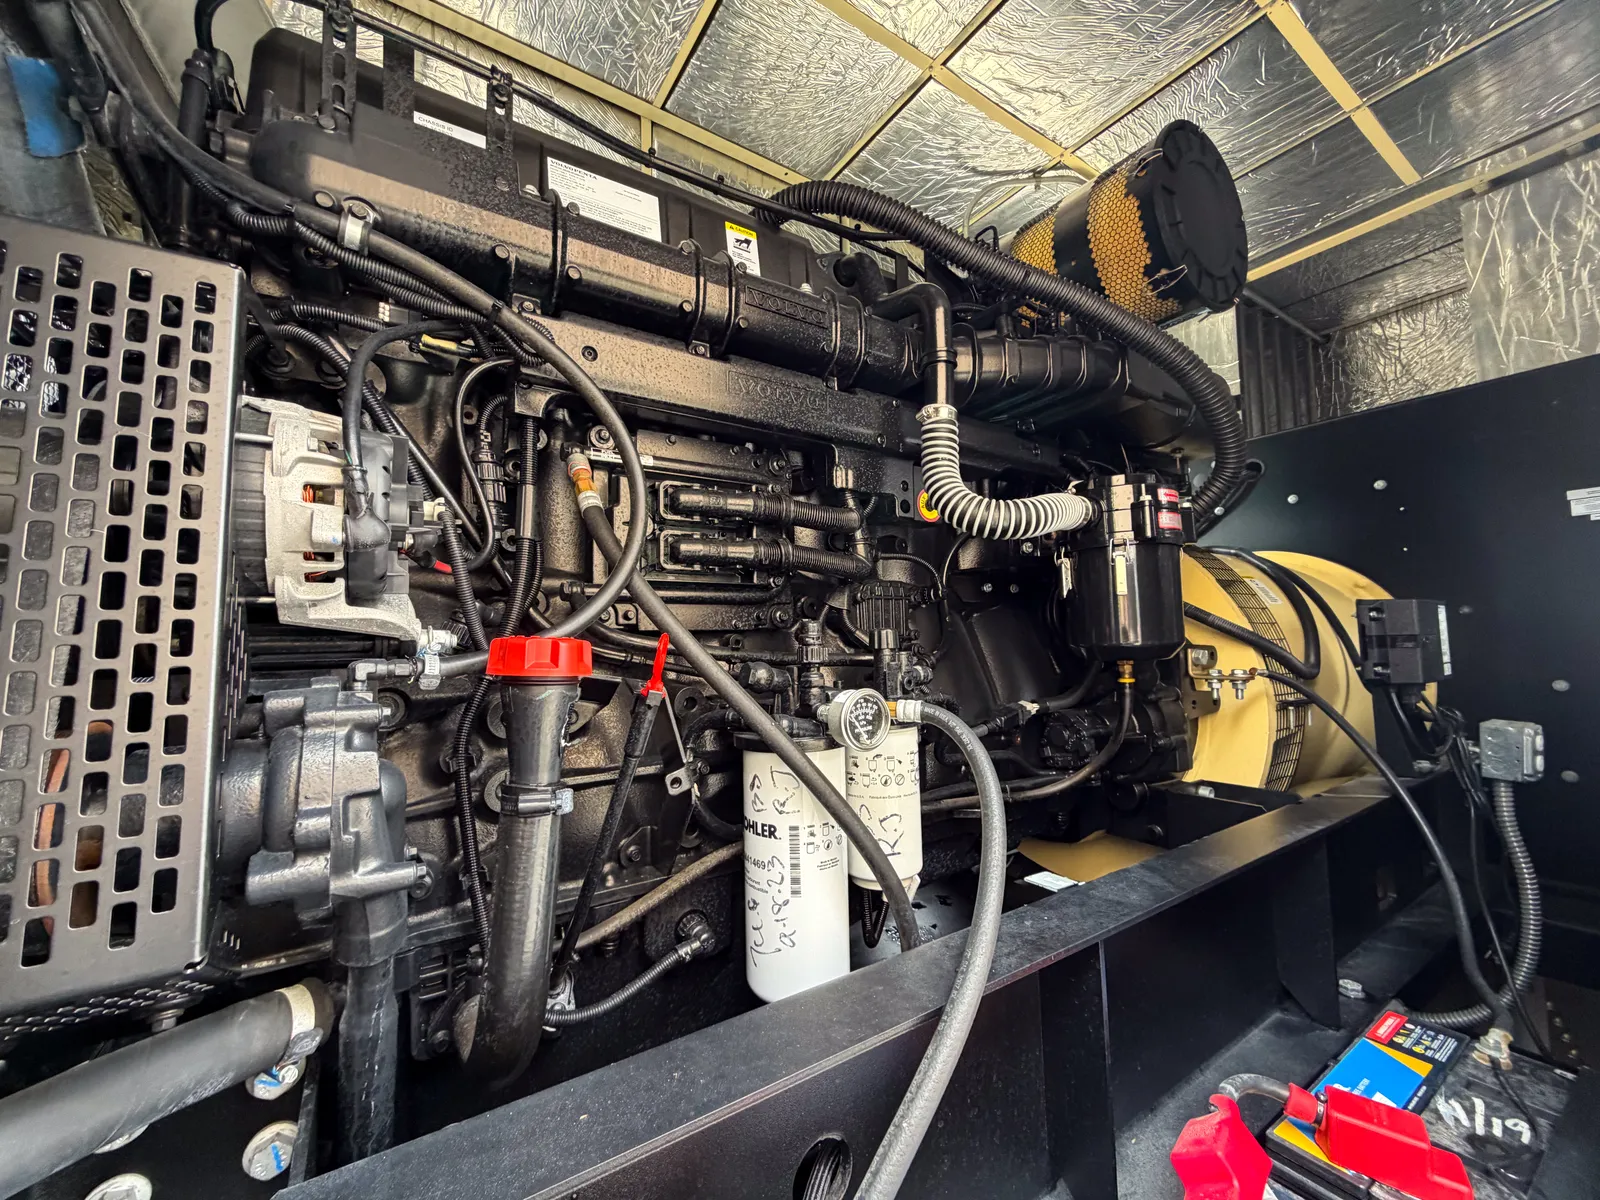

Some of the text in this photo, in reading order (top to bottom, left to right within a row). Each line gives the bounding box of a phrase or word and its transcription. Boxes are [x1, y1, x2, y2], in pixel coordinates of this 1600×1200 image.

[418, 116, 446, 130] CHASSIS
[750, 290, 823, 324] VOLVO
[737, 377, 820, 409] VOLVO
[743, 816, 782, 840] OHLER.
